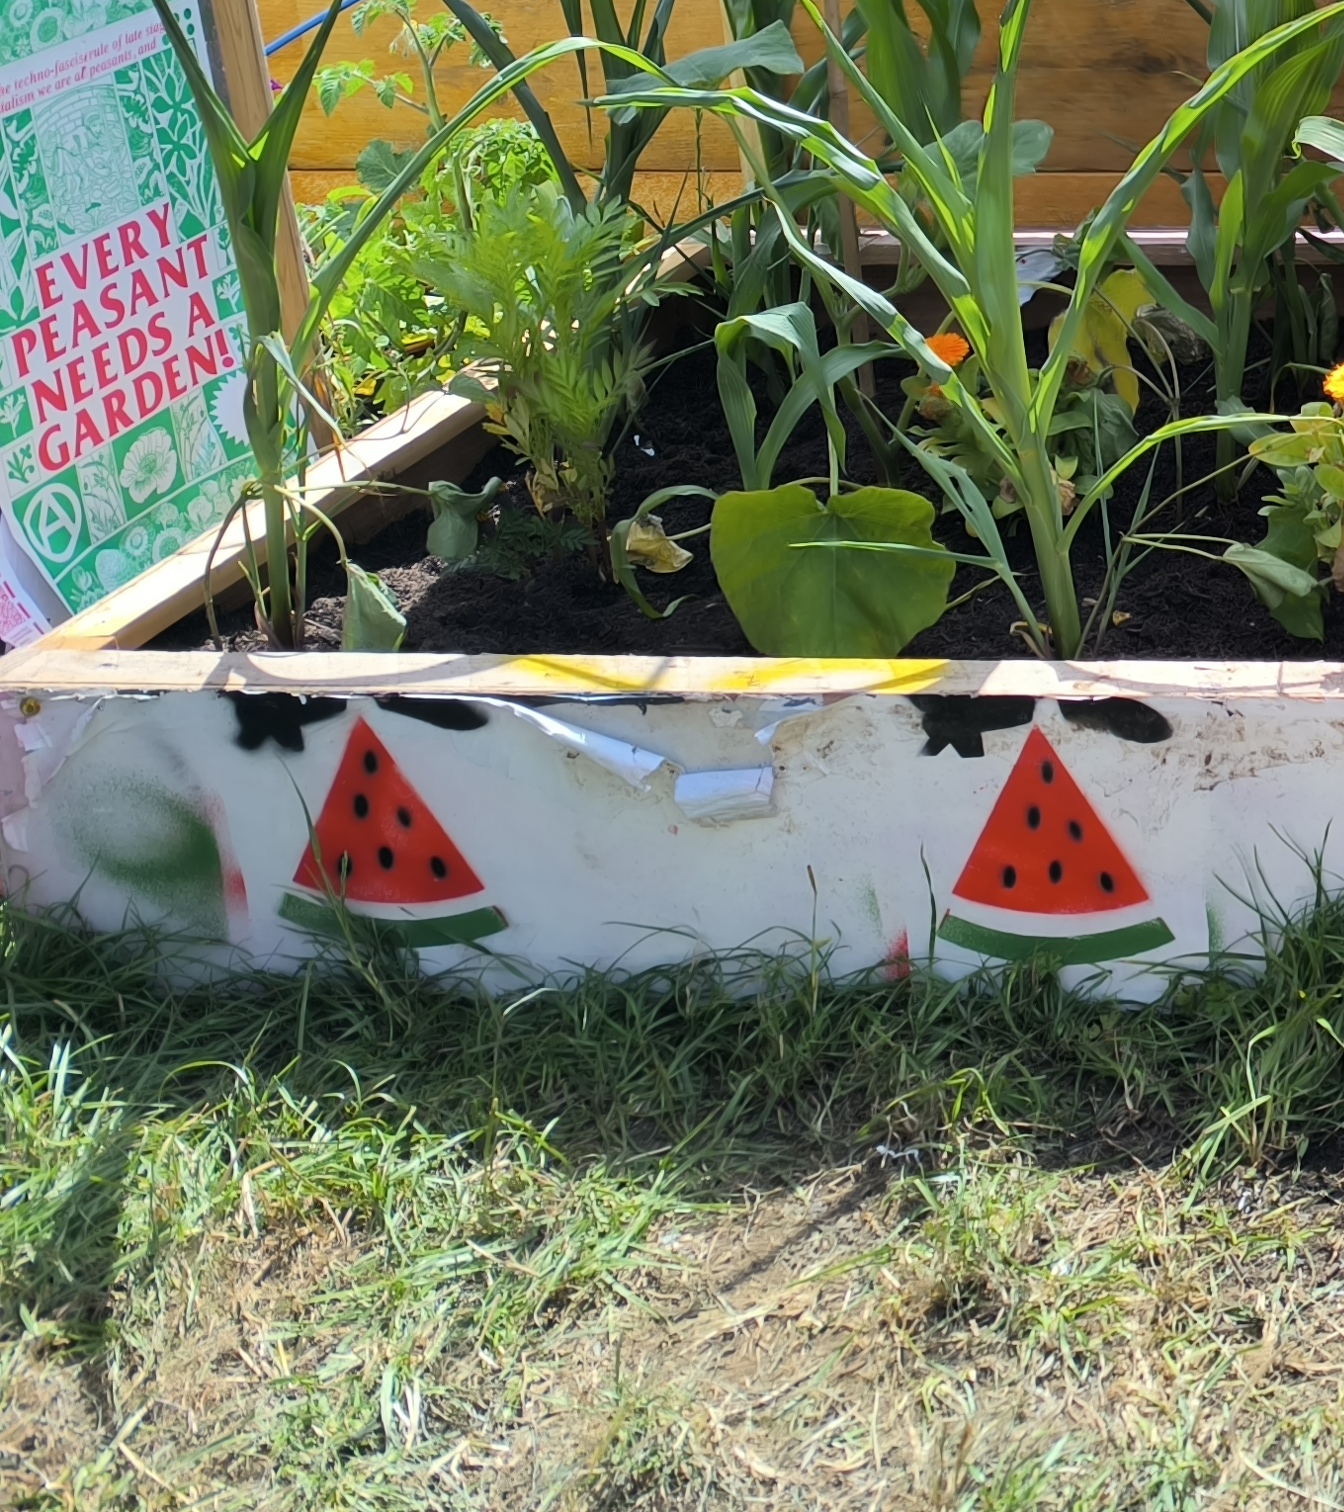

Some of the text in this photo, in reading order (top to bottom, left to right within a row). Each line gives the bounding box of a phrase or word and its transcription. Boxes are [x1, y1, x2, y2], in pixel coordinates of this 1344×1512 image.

[38, 83, 52, 98] we
[55, 76, 72, 91] are
[138, 36, 157, 55] and
[112, 32, 123, 53] of
[145, 21, 166, 36] stag
[11, 233, 209, 378] PEASANT
[35, 202, 172, 310] EVERY
[31, 291, 216, 424] NEEDS A
[37, 328, 235, 473] GARDEN!
